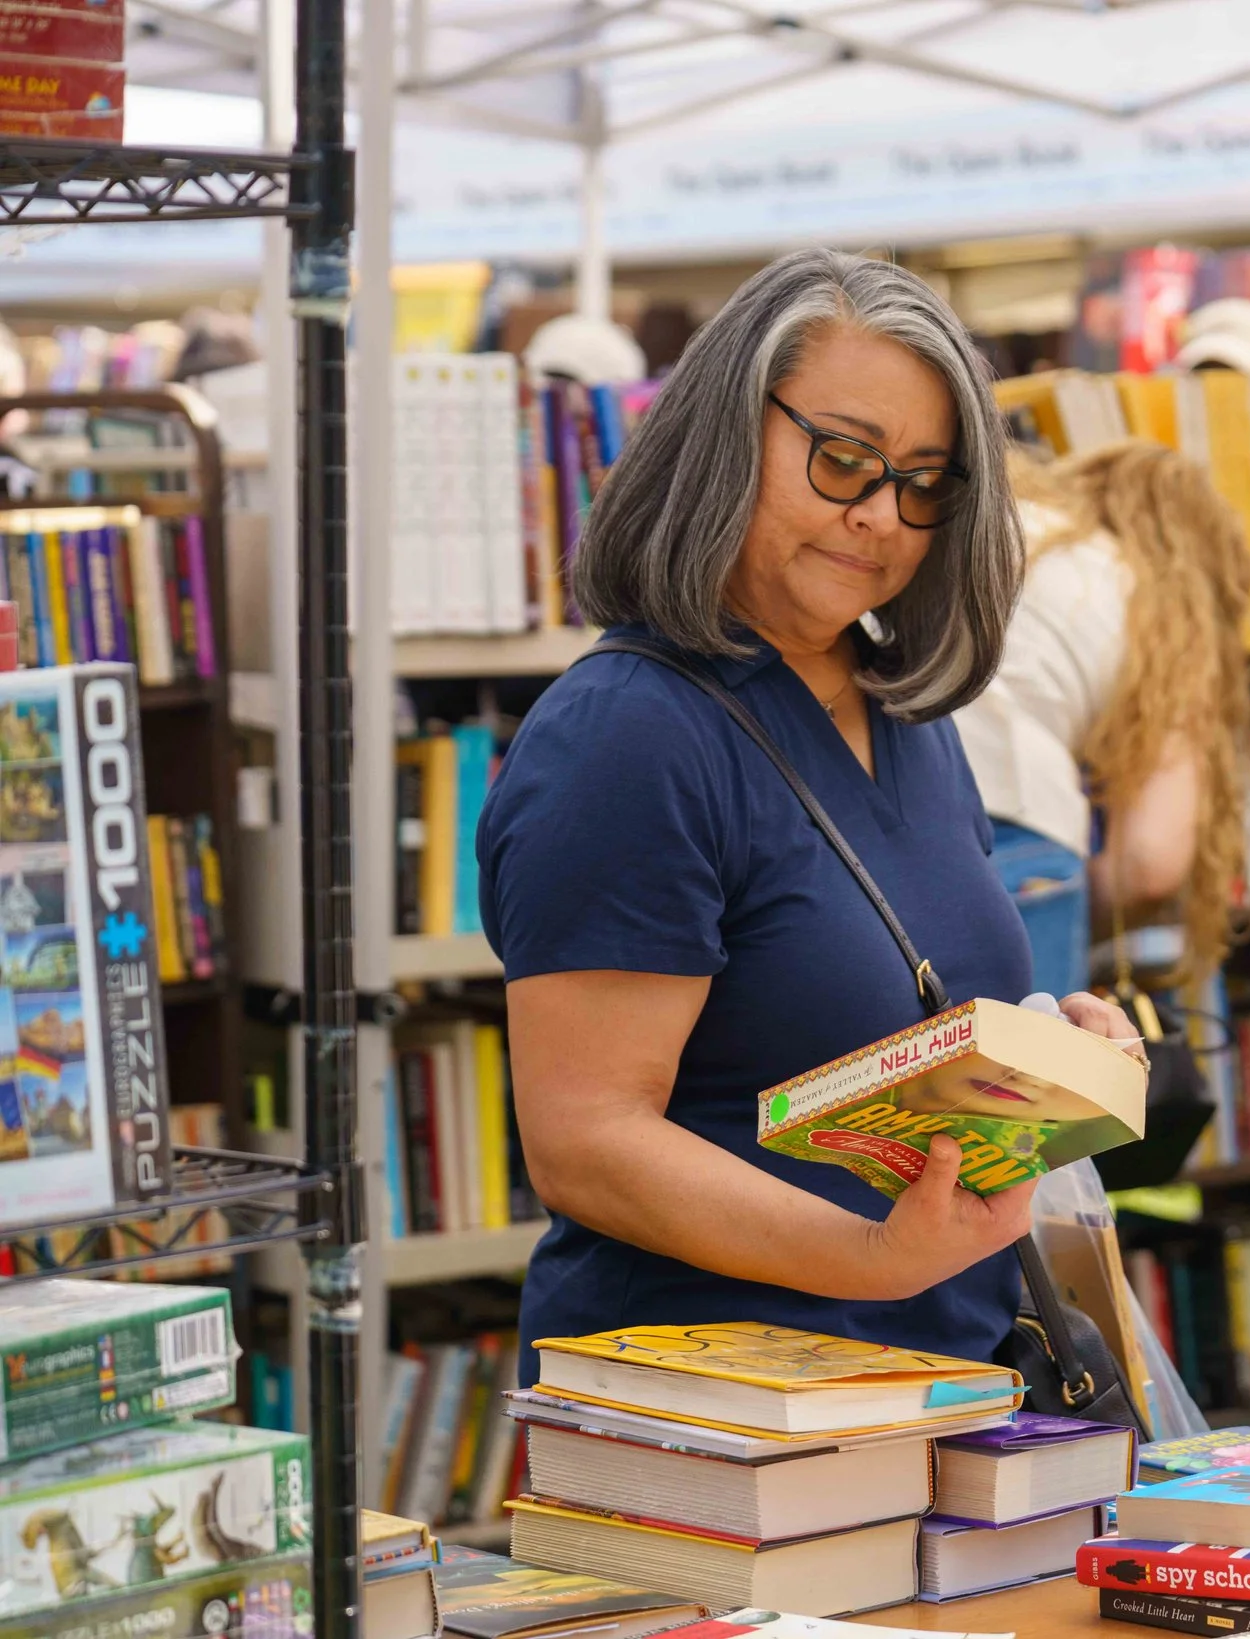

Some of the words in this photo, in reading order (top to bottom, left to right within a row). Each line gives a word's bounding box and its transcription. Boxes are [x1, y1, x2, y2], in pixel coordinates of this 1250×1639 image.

[83, 678, 139, 911] 1000
[928, 1019, 972, 1054] AMY
[880, 1043, 922, 1075] TAN
[122, 961, 163, 1191] PUZZLE
[833, 1073, 862, 1089] VALLEY
[790, 1089, 823, 1109] AMAZEM
[835, 1102, 953, 1140] AMY
[957, 1129, 1030, 1191] TAN
[893, 1147, 925, 1168] VALLE
[1156, 1565, 1197, 1591] spy
[1113, 1599, 1144, 1614] Crooked
[1147, 1604, 1169, 1617] Little
[1171, 1608, 1195, 1622] Heart
